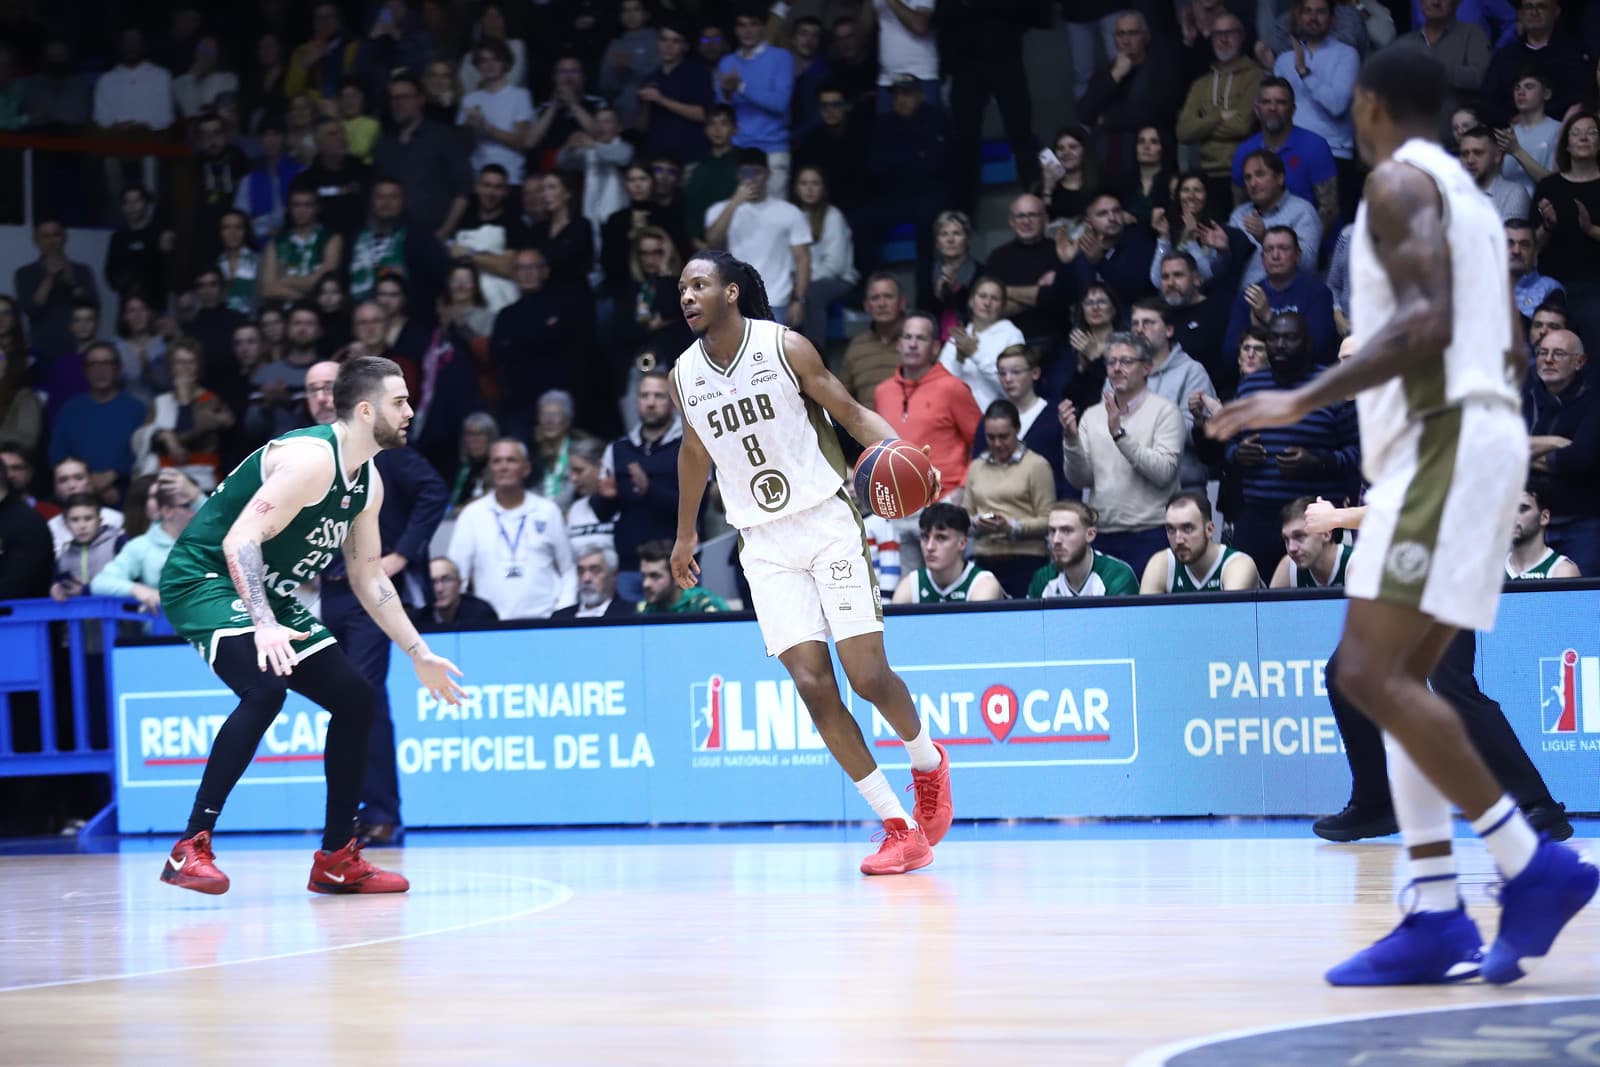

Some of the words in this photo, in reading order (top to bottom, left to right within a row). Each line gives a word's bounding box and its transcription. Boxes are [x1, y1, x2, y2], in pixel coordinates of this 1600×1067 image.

[707, 393, 775, 439] SQBB
[742, 434, 766, 466] 8
[416, 680, 627, 721] PARTENAIRE
[871, 692, 975, 738] RNT
[1023, 688, 1111, 734] CAR
[397, 736, 547, 774] OFFICIEL
[553, 733, 601, 769] DE
[609, 732, 655, 768] LA
[1183, 717, 1346, 757] OFFICIE
[1541, 739, 1577, 752] LIGUE
[723, 754, 779, 767] NATIONALE
[791, 753, 830, 766] BASKET
